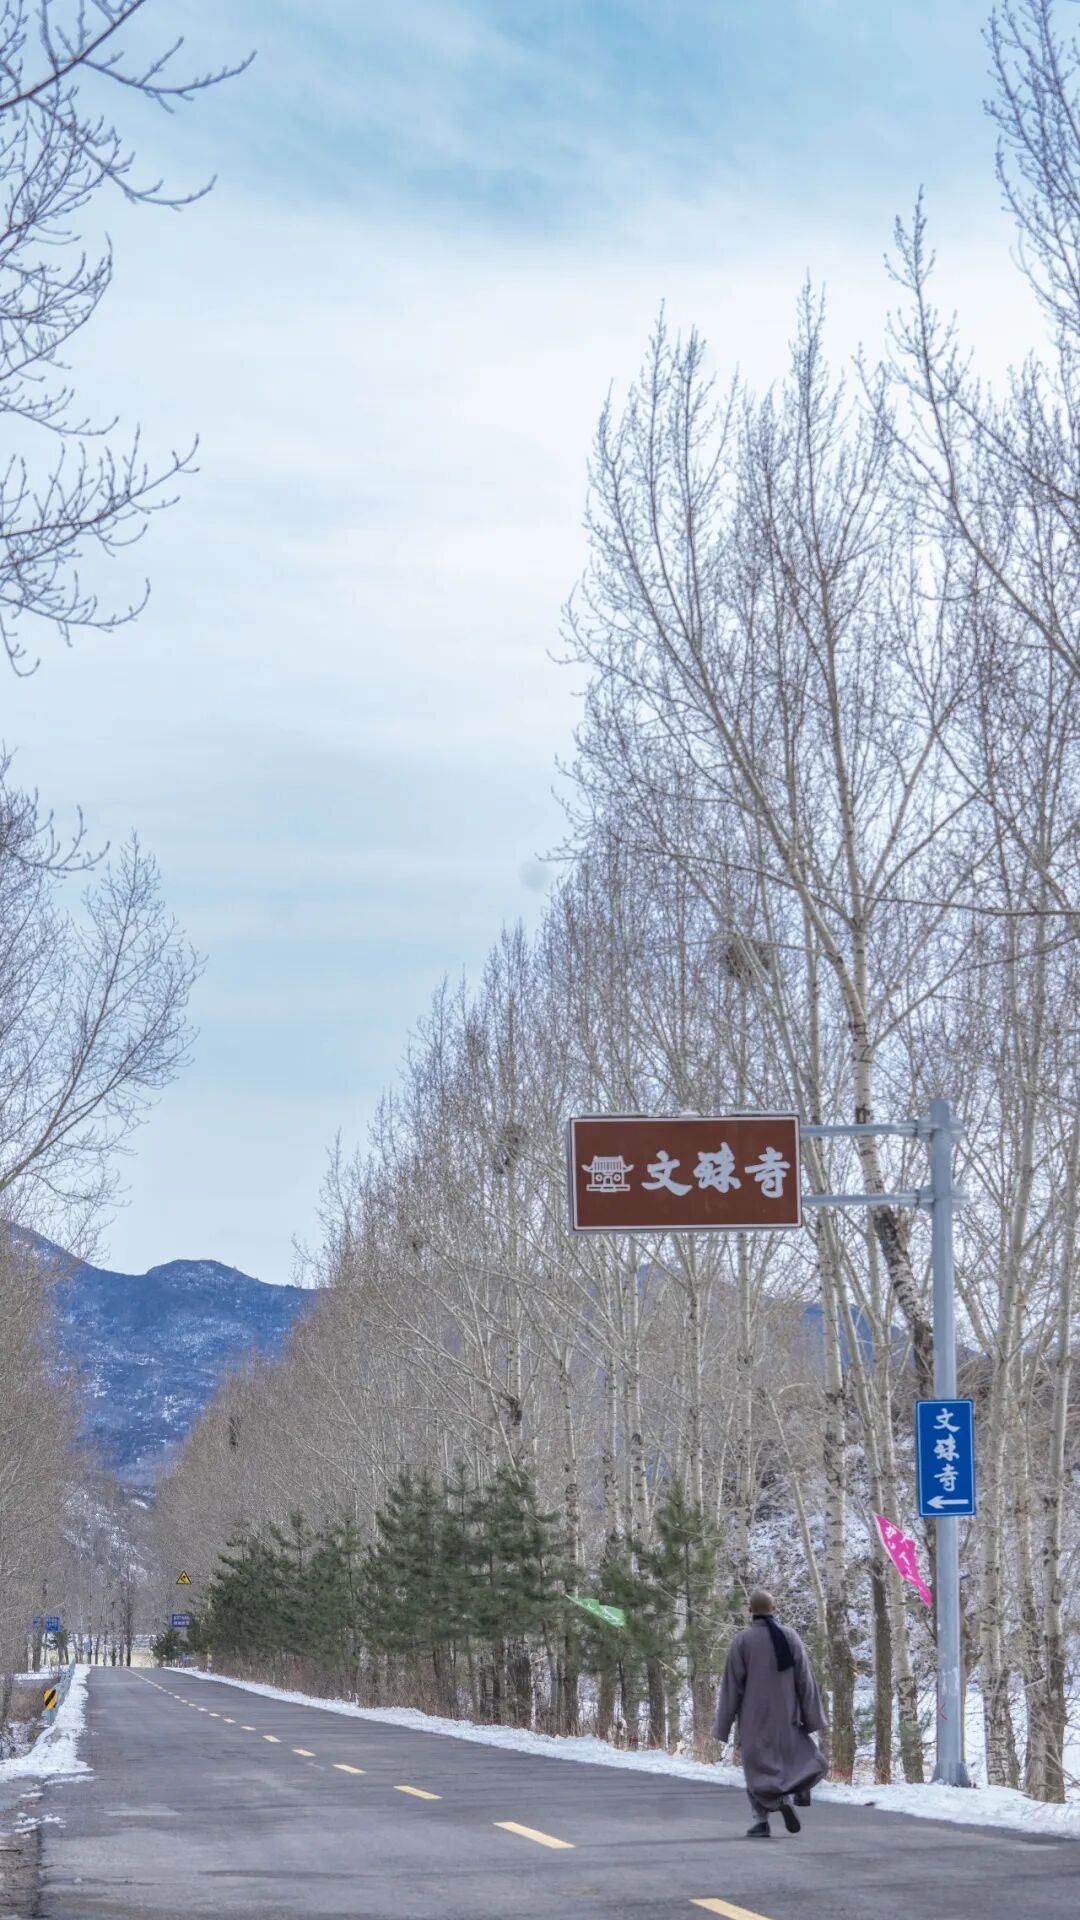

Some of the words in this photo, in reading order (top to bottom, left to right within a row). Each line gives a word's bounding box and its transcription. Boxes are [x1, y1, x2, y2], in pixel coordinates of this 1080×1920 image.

[641, 1141, 791, 1198] 文殊寺
[933, 1407, 960, 1492] 文殊寺
